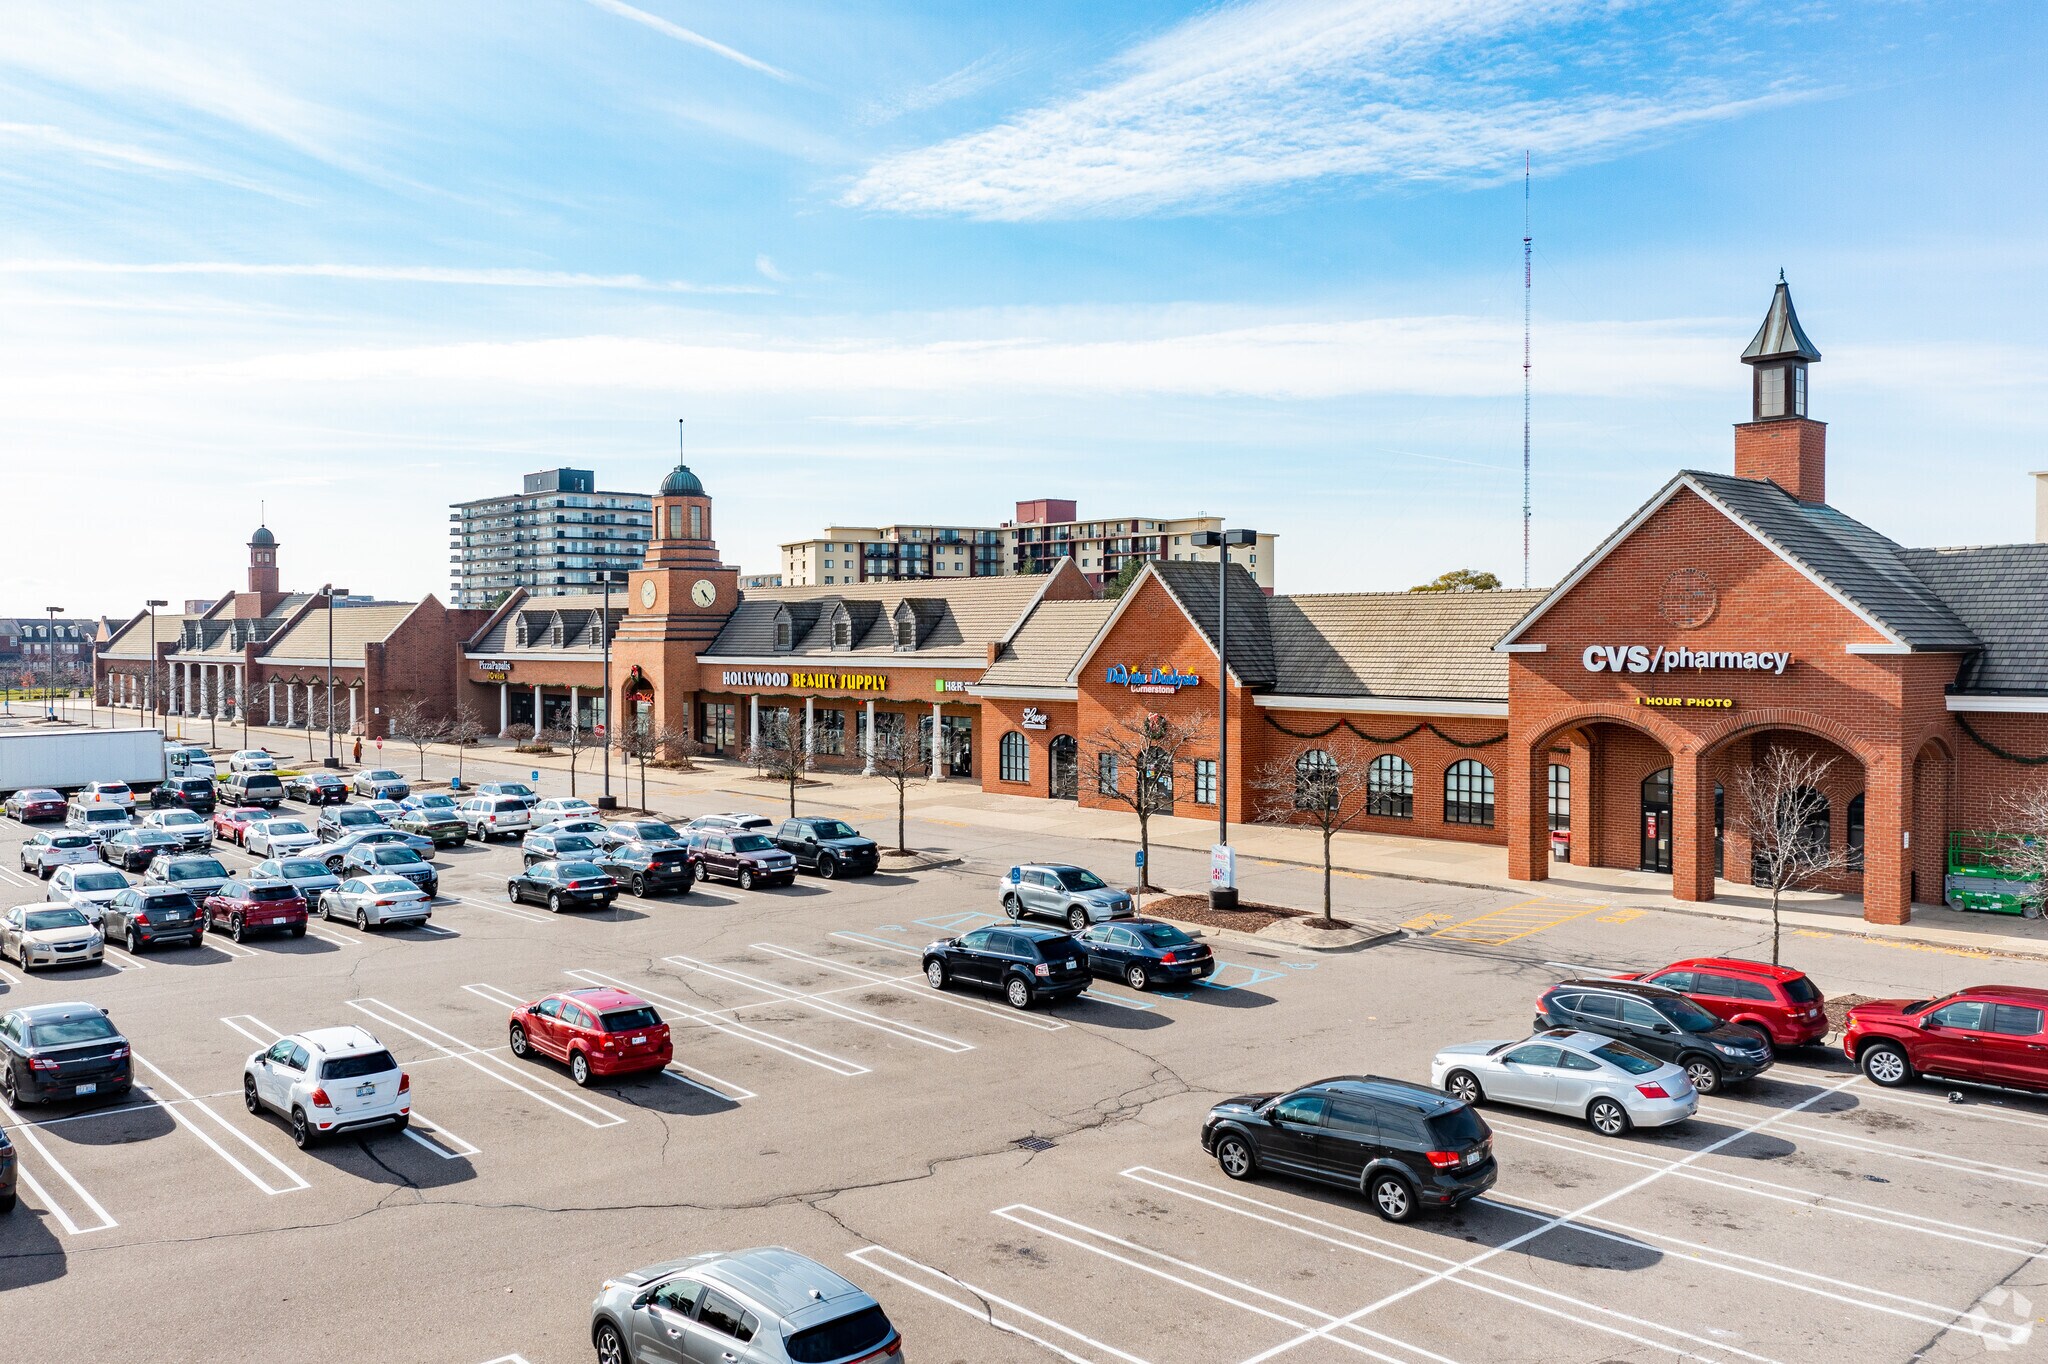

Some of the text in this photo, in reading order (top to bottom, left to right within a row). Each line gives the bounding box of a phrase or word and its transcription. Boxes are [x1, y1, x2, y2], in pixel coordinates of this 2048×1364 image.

[1582, 645, 1790, 675] CVS/pharmacy
[722, 671, 887, 691] HOLLYWOOD BEAUTY SUPPLY
[945, 681, 964, 692] H&R
[1130, 684, 1175, 694] Cornerstone
[1635, 697, 1733, 708] 1 HOUR PHOTO
[1022, 707, 1048, 725] Luxe
